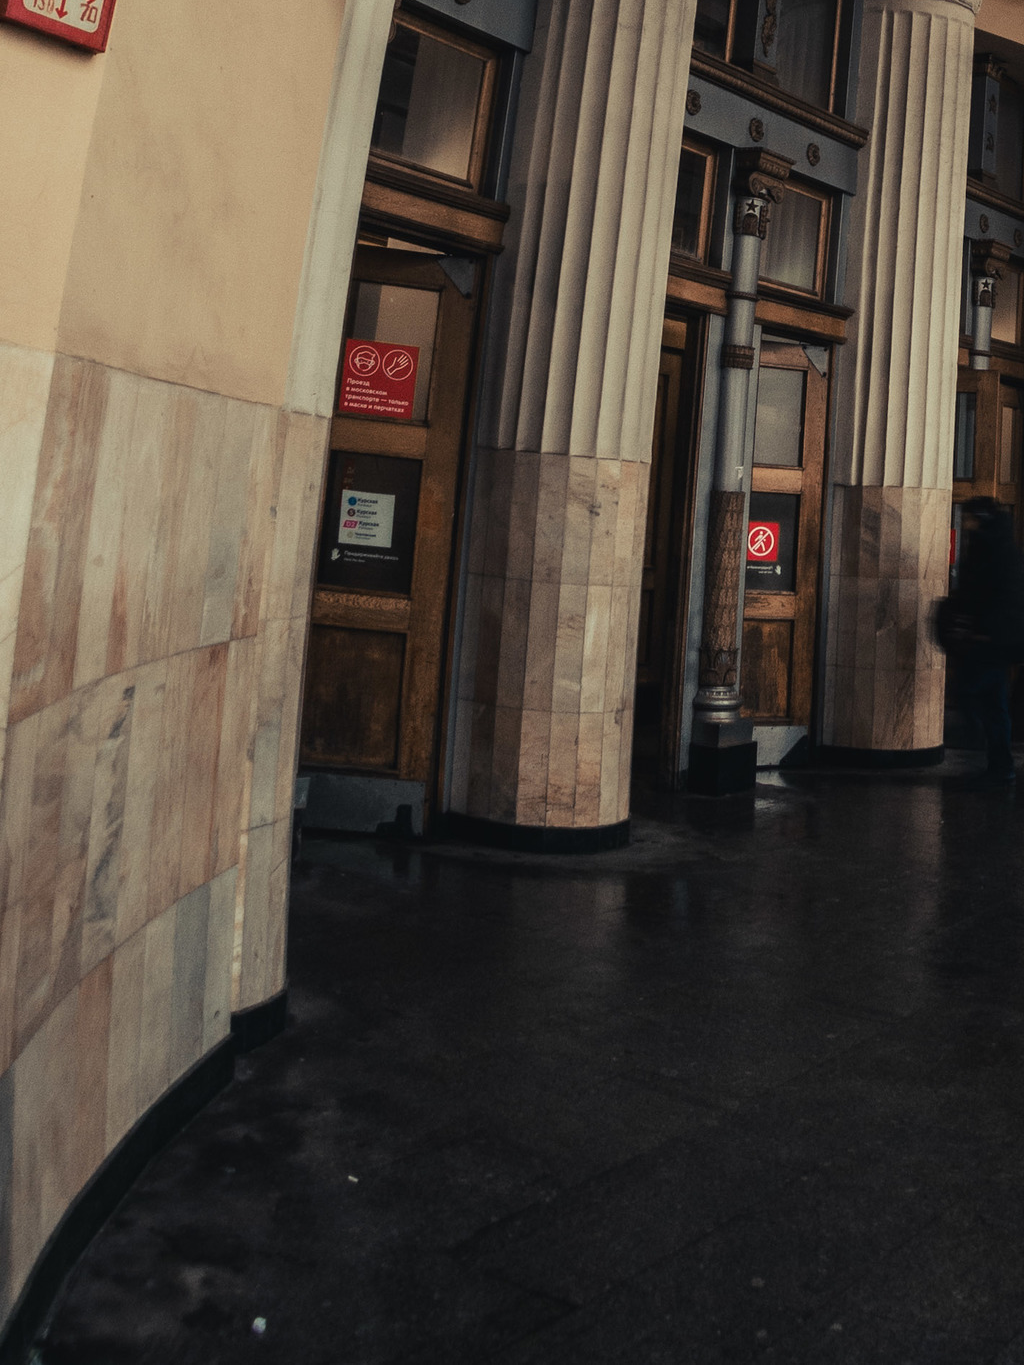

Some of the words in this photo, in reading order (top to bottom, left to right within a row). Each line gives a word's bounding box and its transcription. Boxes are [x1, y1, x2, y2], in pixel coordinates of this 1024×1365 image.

[80, 2, 98, 24] 70
[347, 378, 370, 386] Проезд
[351, 387, 387, 395] московском
[345, 394, 379, 402] транспорте
